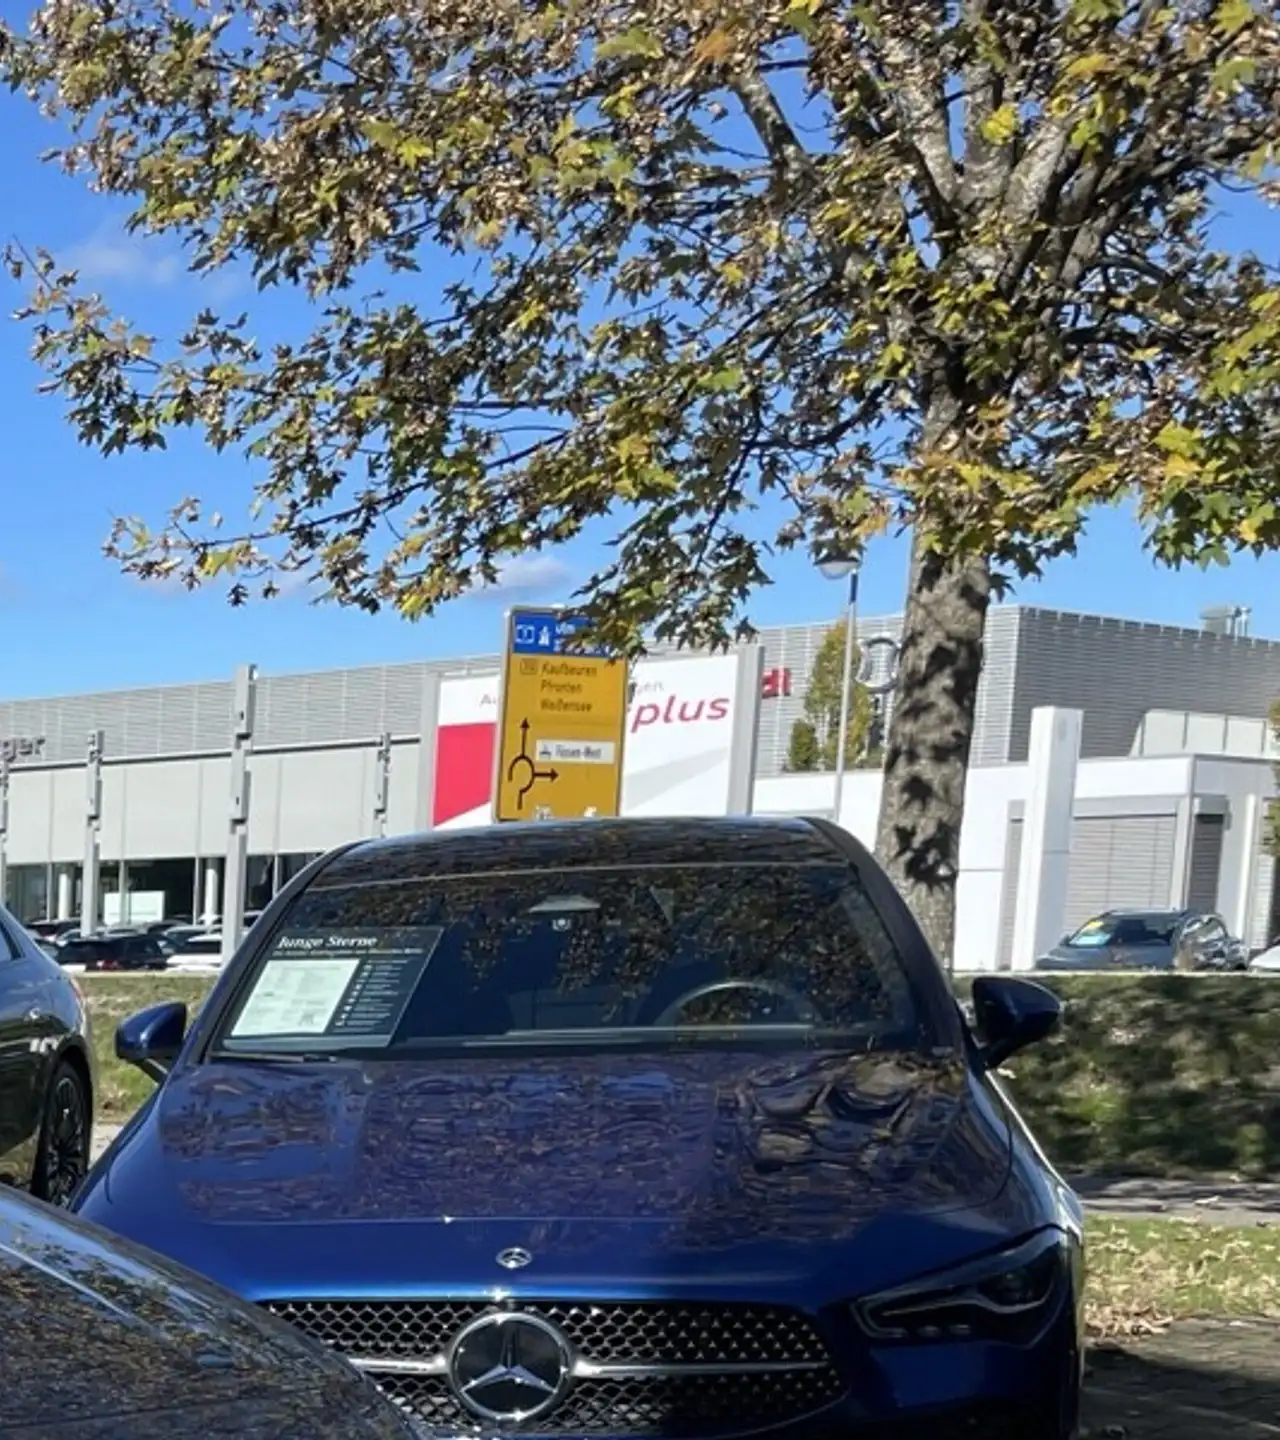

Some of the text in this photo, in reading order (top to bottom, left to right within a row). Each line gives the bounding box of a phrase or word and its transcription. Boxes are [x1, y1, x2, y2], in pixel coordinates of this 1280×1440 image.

[630, 693, 730, 734] plus
[276, 934, 377, 949] Junge Sterne
